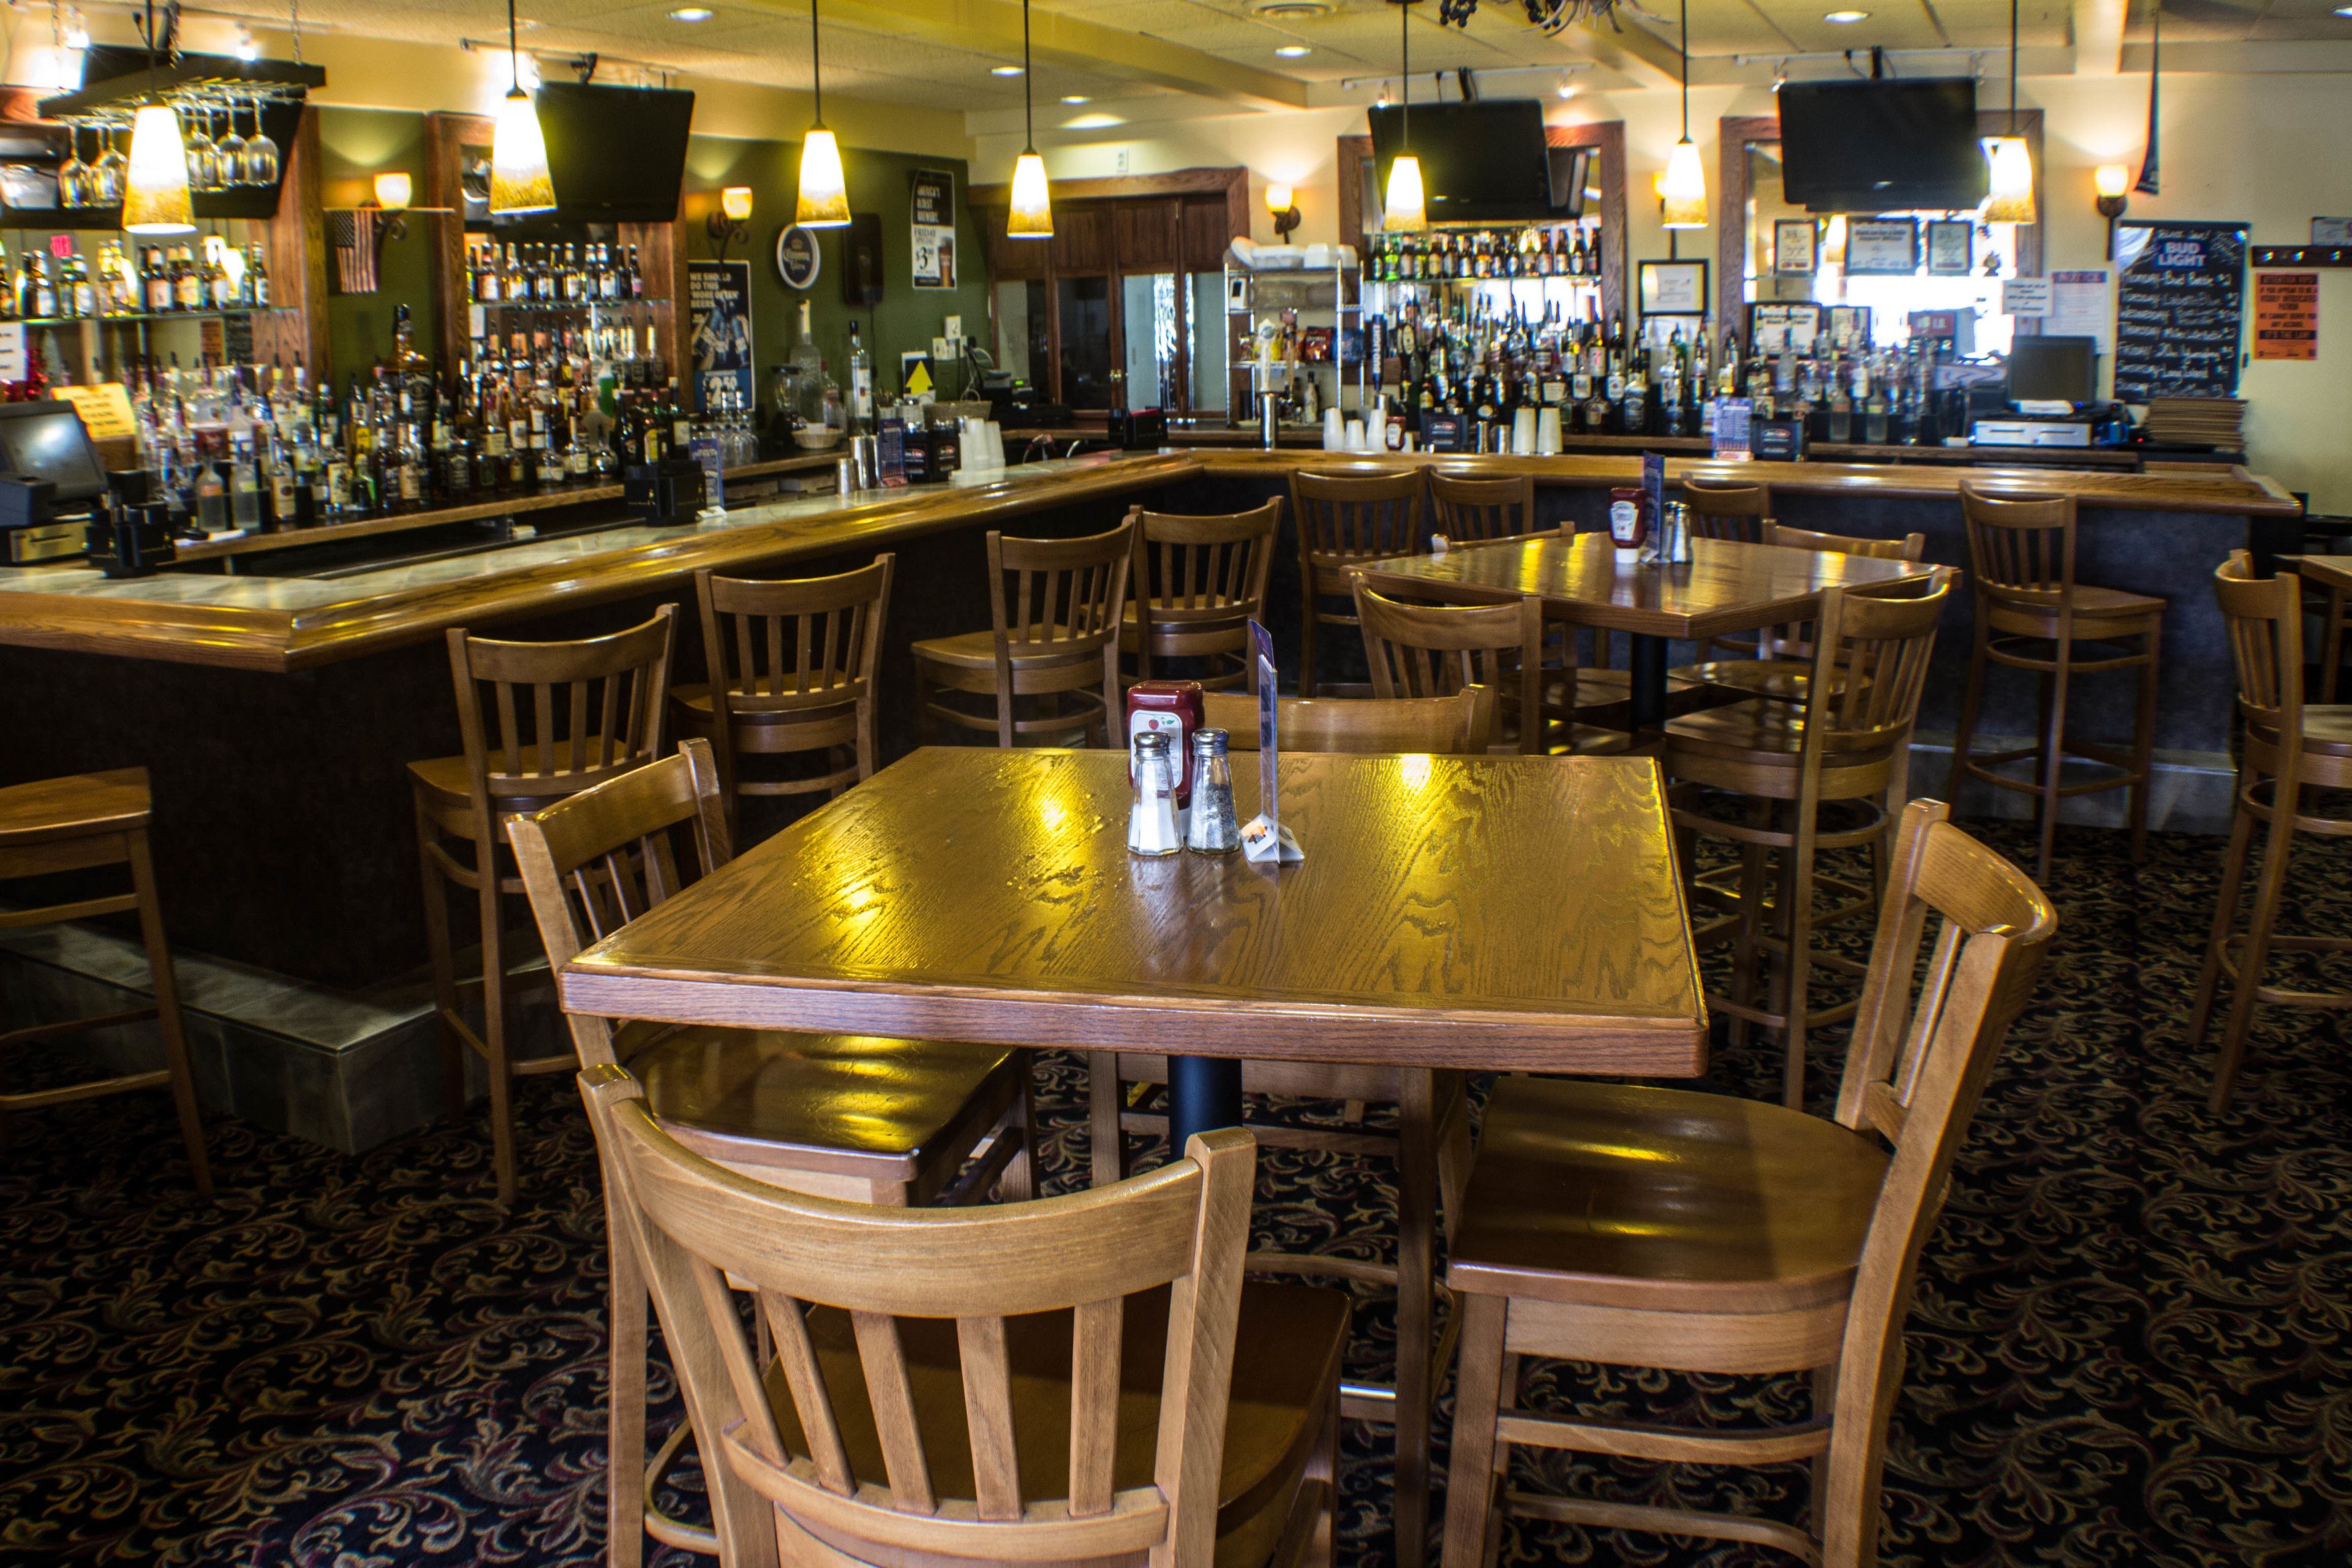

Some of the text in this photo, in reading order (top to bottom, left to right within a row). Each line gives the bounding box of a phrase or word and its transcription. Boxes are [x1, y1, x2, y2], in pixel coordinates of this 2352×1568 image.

[914, 227, 935, 236] FRIDAY
[2166, 242, 2200, 255] BUD
[2158, 254, 2206, 266] LIGHT
[690, 273, 732, 282] WE SHOLD
[1373, 325, 1381, 374] BUD LIGHT
